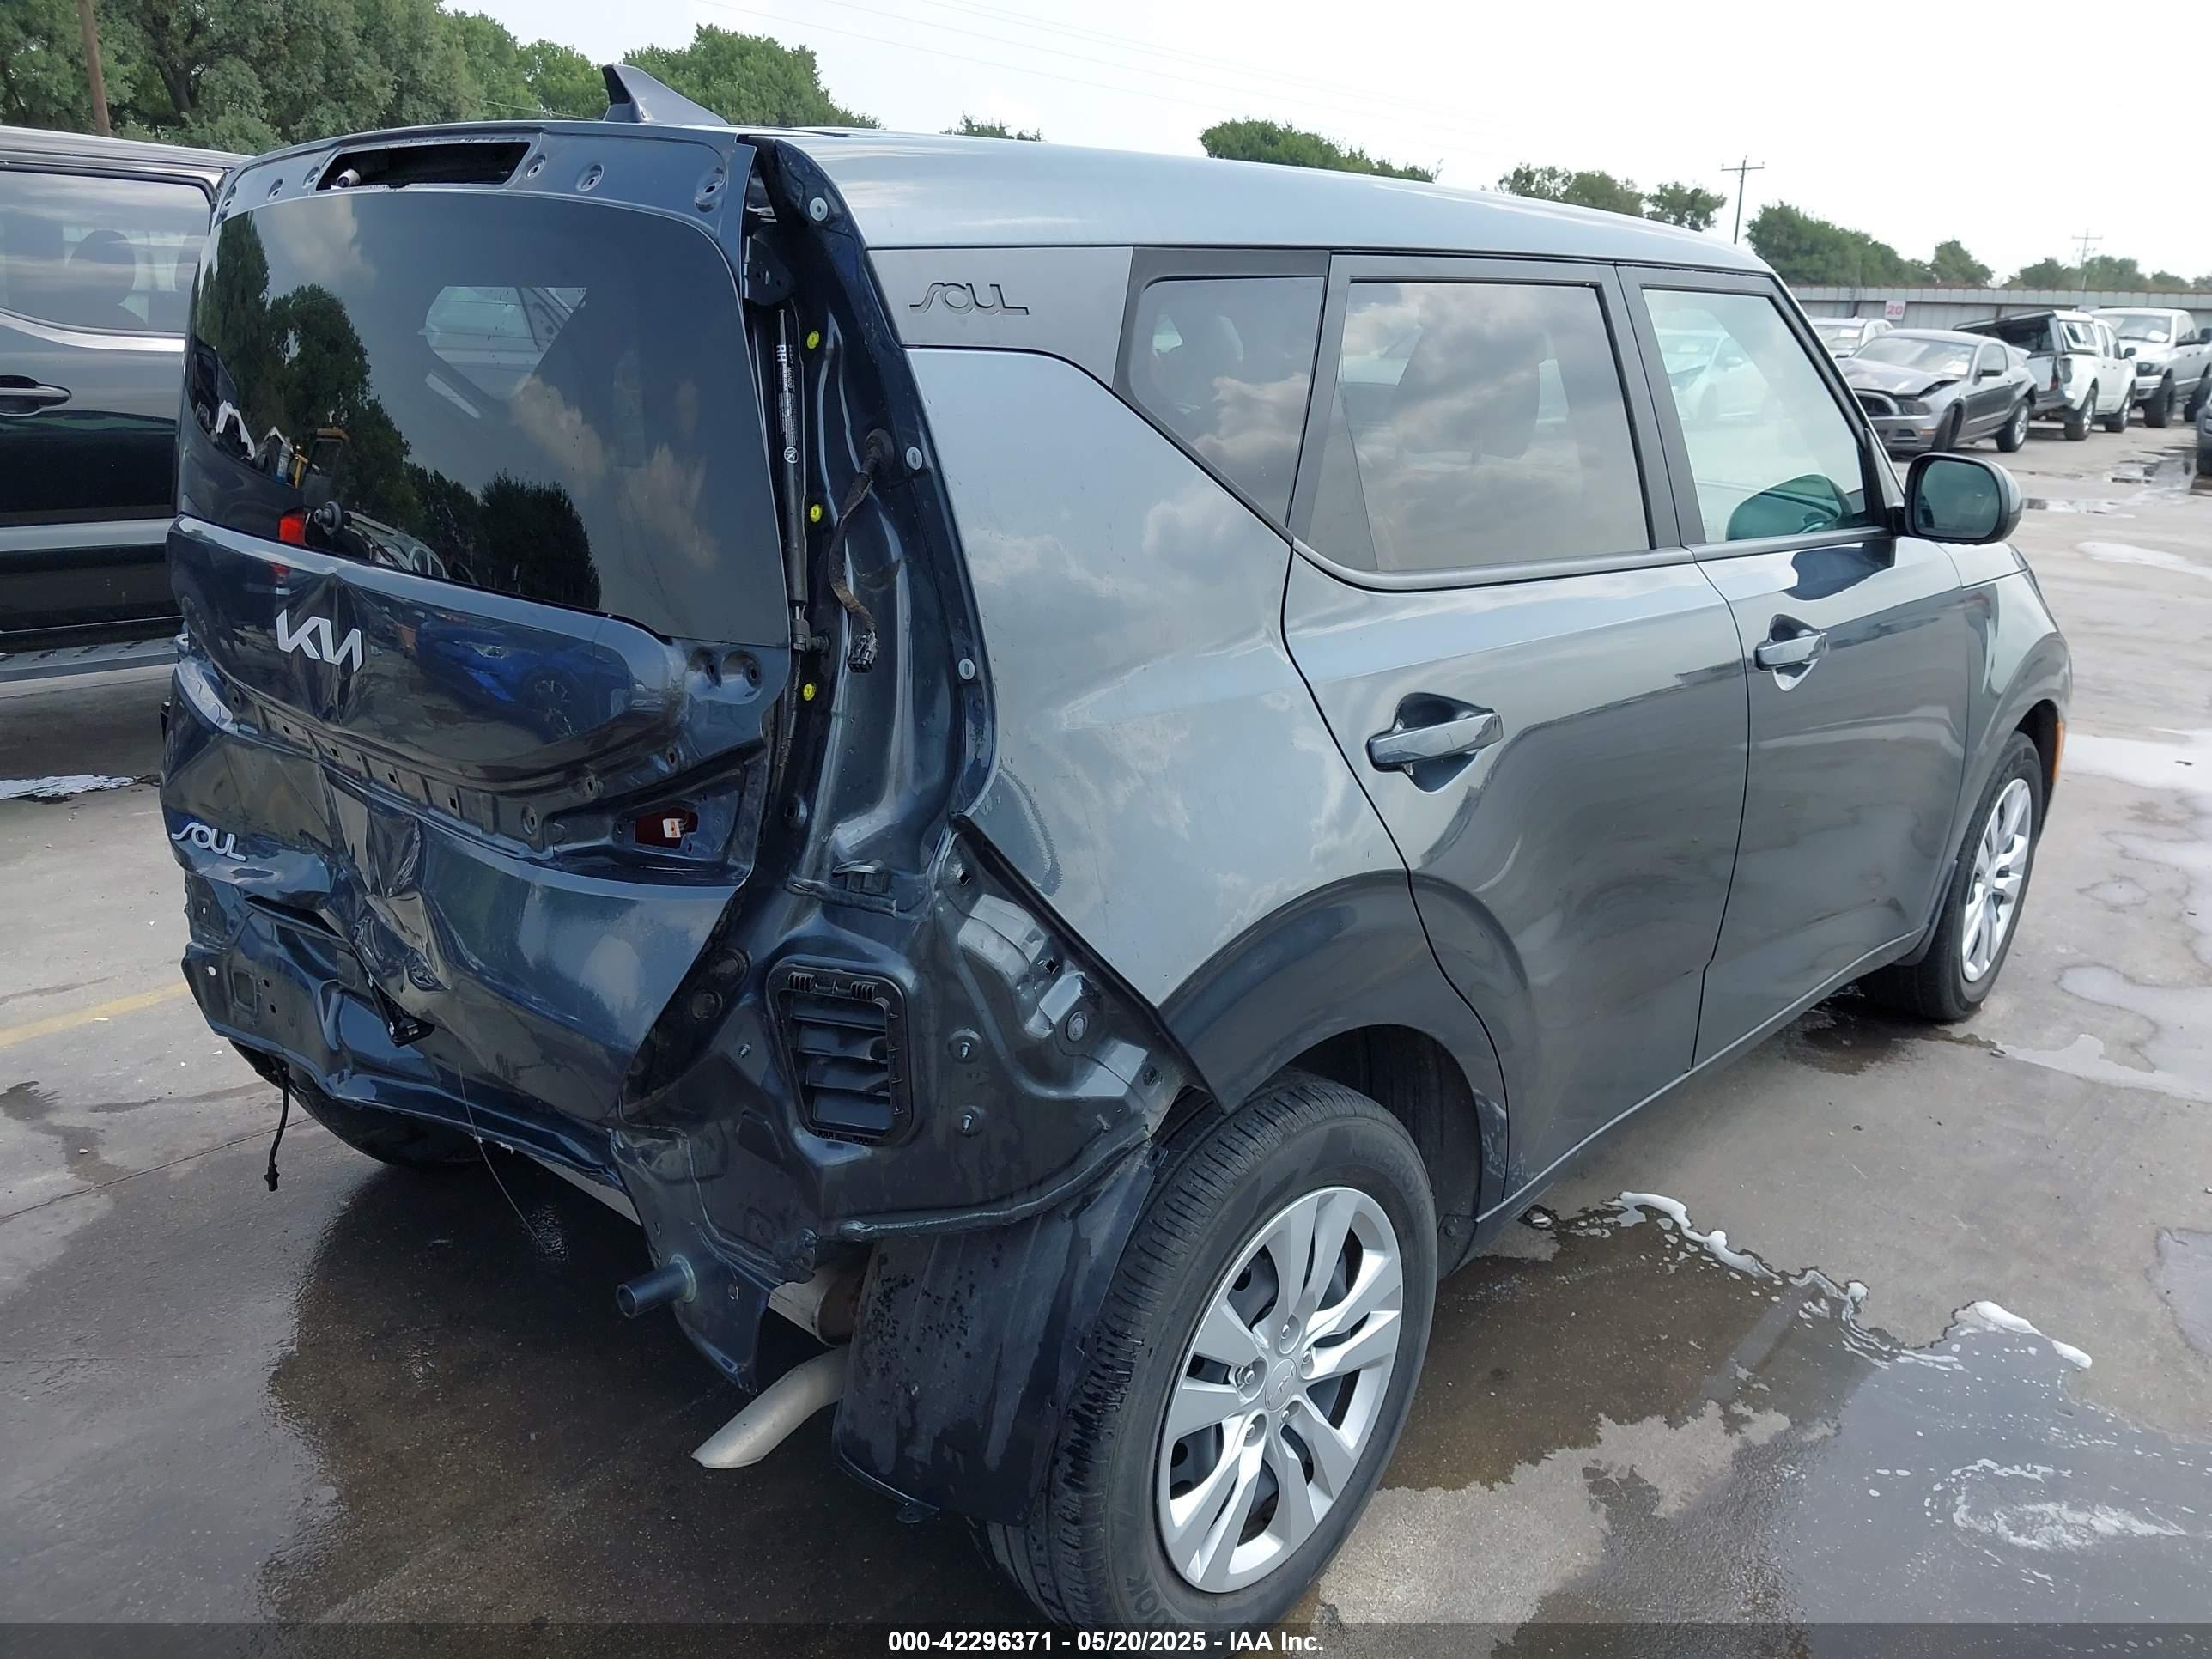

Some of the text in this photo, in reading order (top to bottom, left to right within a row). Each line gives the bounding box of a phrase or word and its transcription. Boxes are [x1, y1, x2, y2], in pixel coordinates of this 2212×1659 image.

[908, 282, 1030, 315] SOUL
[1887, 305, 1904, 316] 20
[776, 344, 787, 362] RH
[171, 822, 246, 861] SOUL
